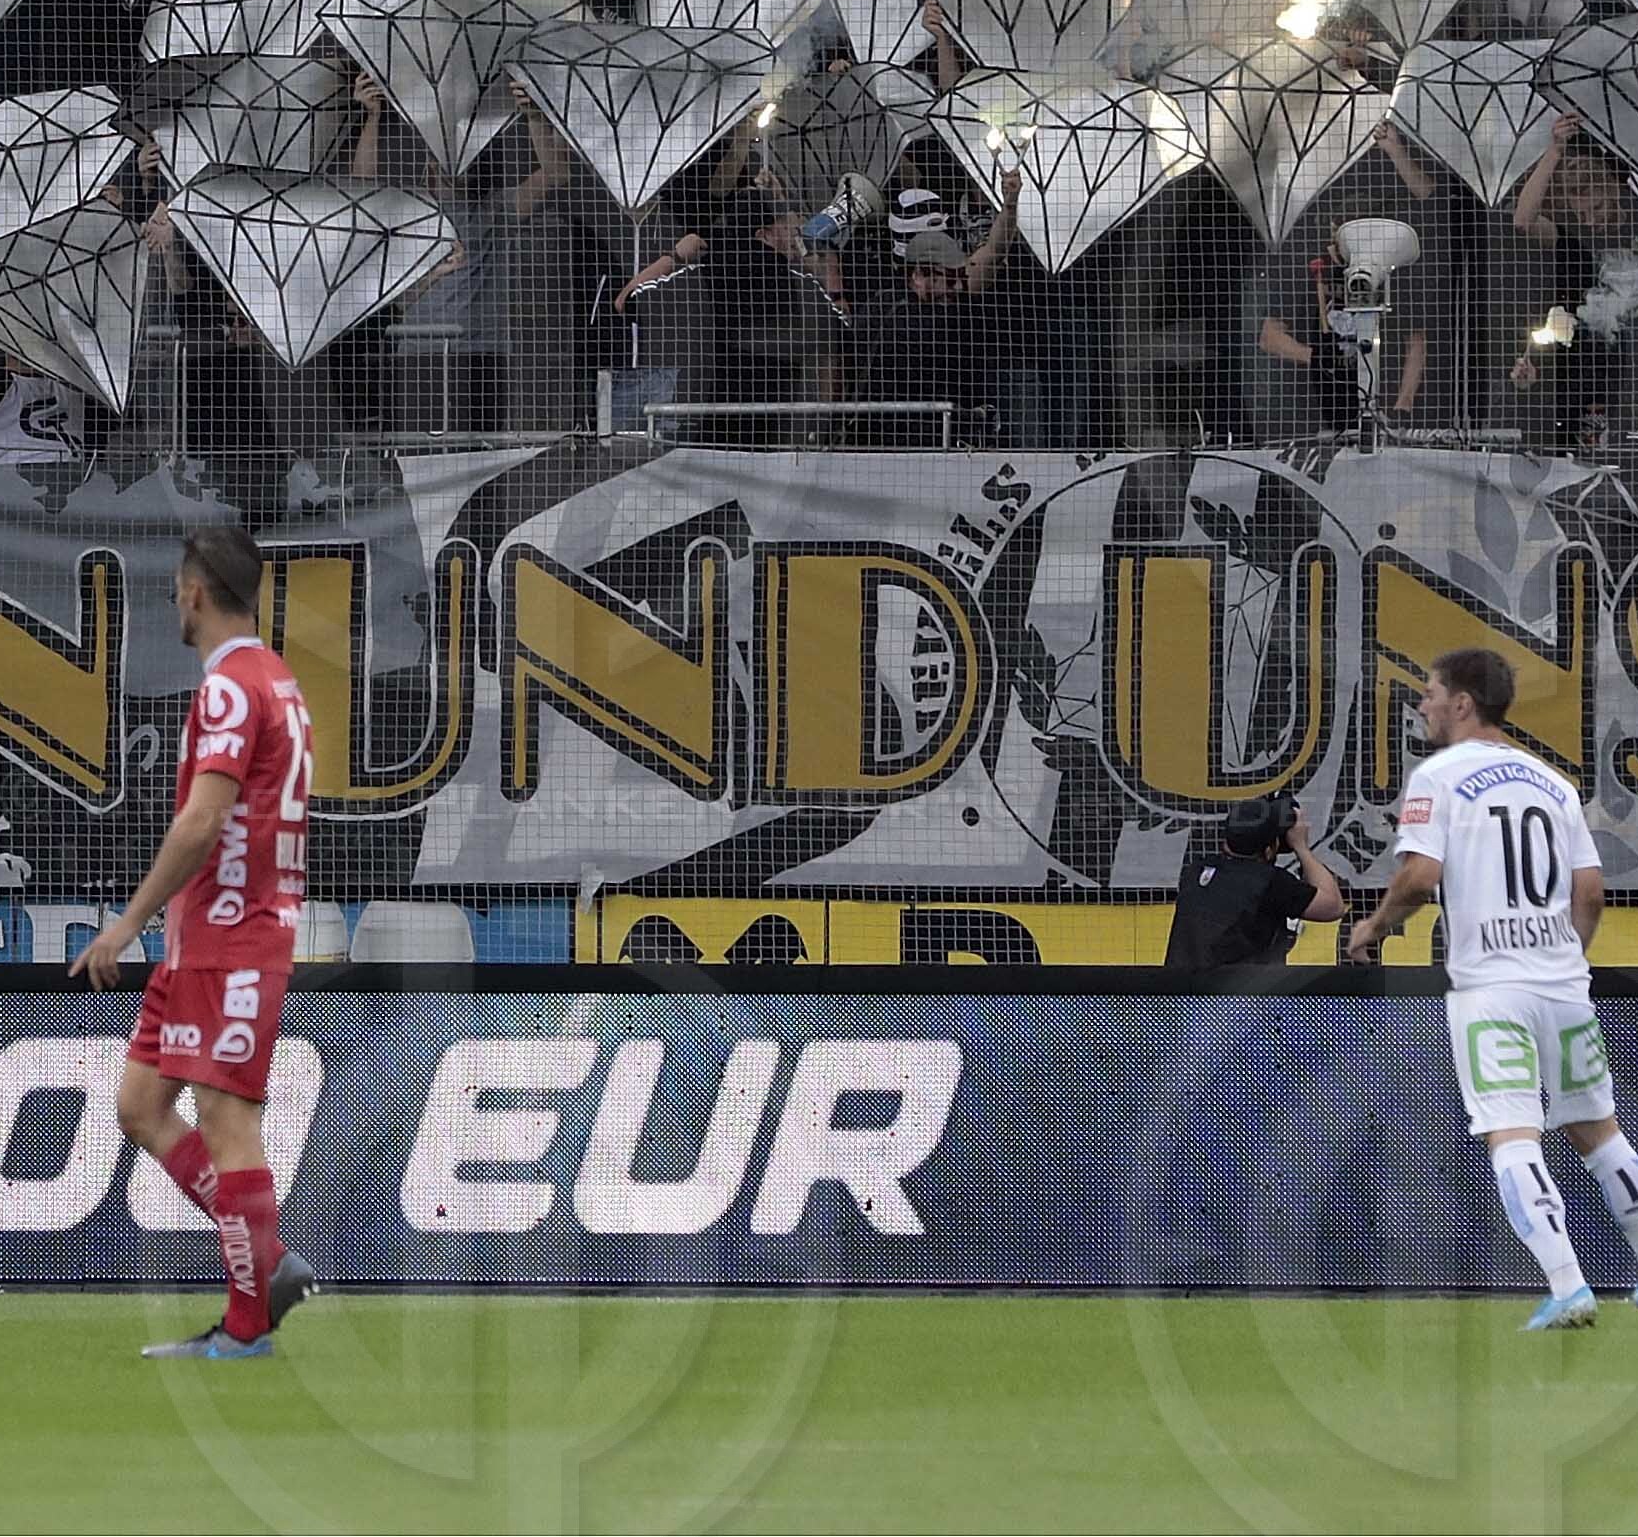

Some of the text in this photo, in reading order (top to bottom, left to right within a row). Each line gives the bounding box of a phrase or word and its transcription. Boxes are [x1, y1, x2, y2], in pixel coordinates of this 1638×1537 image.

[259, 546, 978, 811] UND
[1460, 765, 1565, 802] PUNTIGAMER
[1489, 806, 1556, 909] 10
[400, 1037, 964, 1235] EUR
